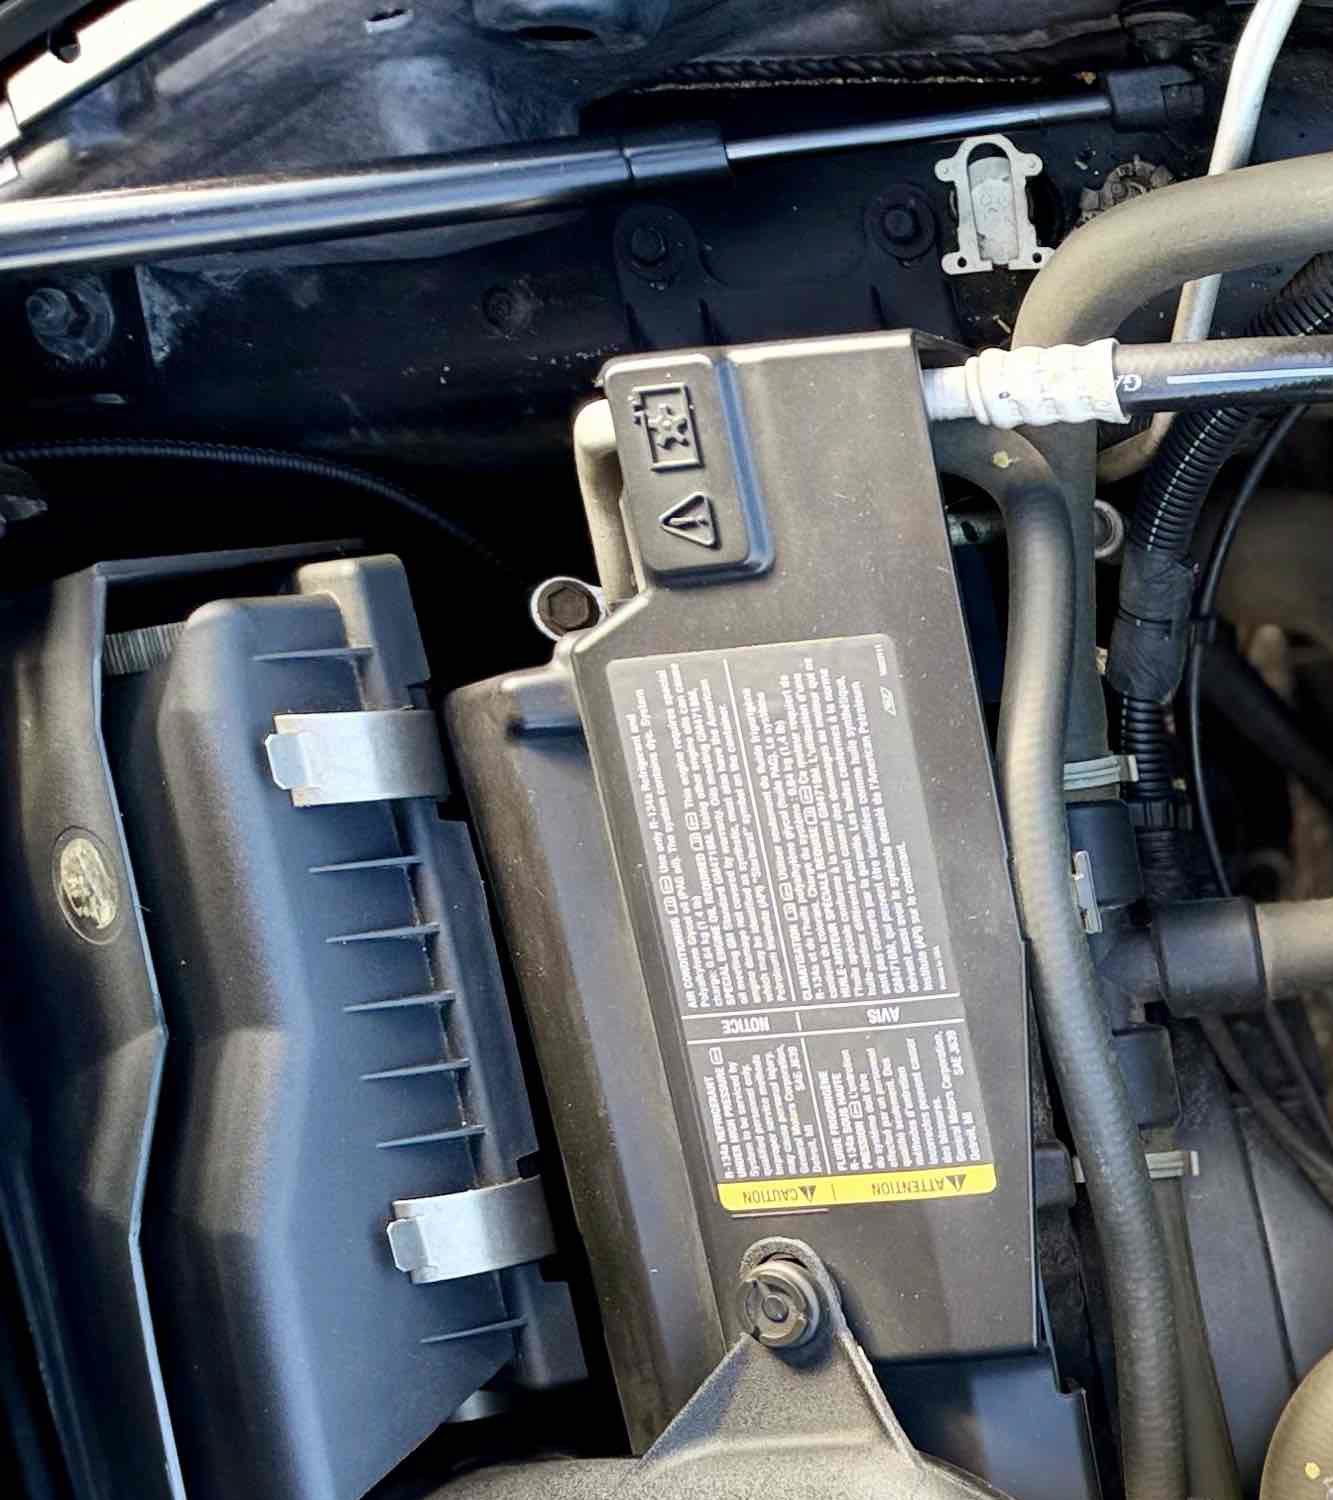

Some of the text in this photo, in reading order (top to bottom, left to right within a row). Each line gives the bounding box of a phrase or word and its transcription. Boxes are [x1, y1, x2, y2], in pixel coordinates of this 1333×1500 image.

[865, 1005, 902, 1024] AVIS
[719, 1014, 771, 1035] NOTICE
[743, 1186, 798, 1203] CAUTION
[872, 1178, 944, 1197] ATTENTION
